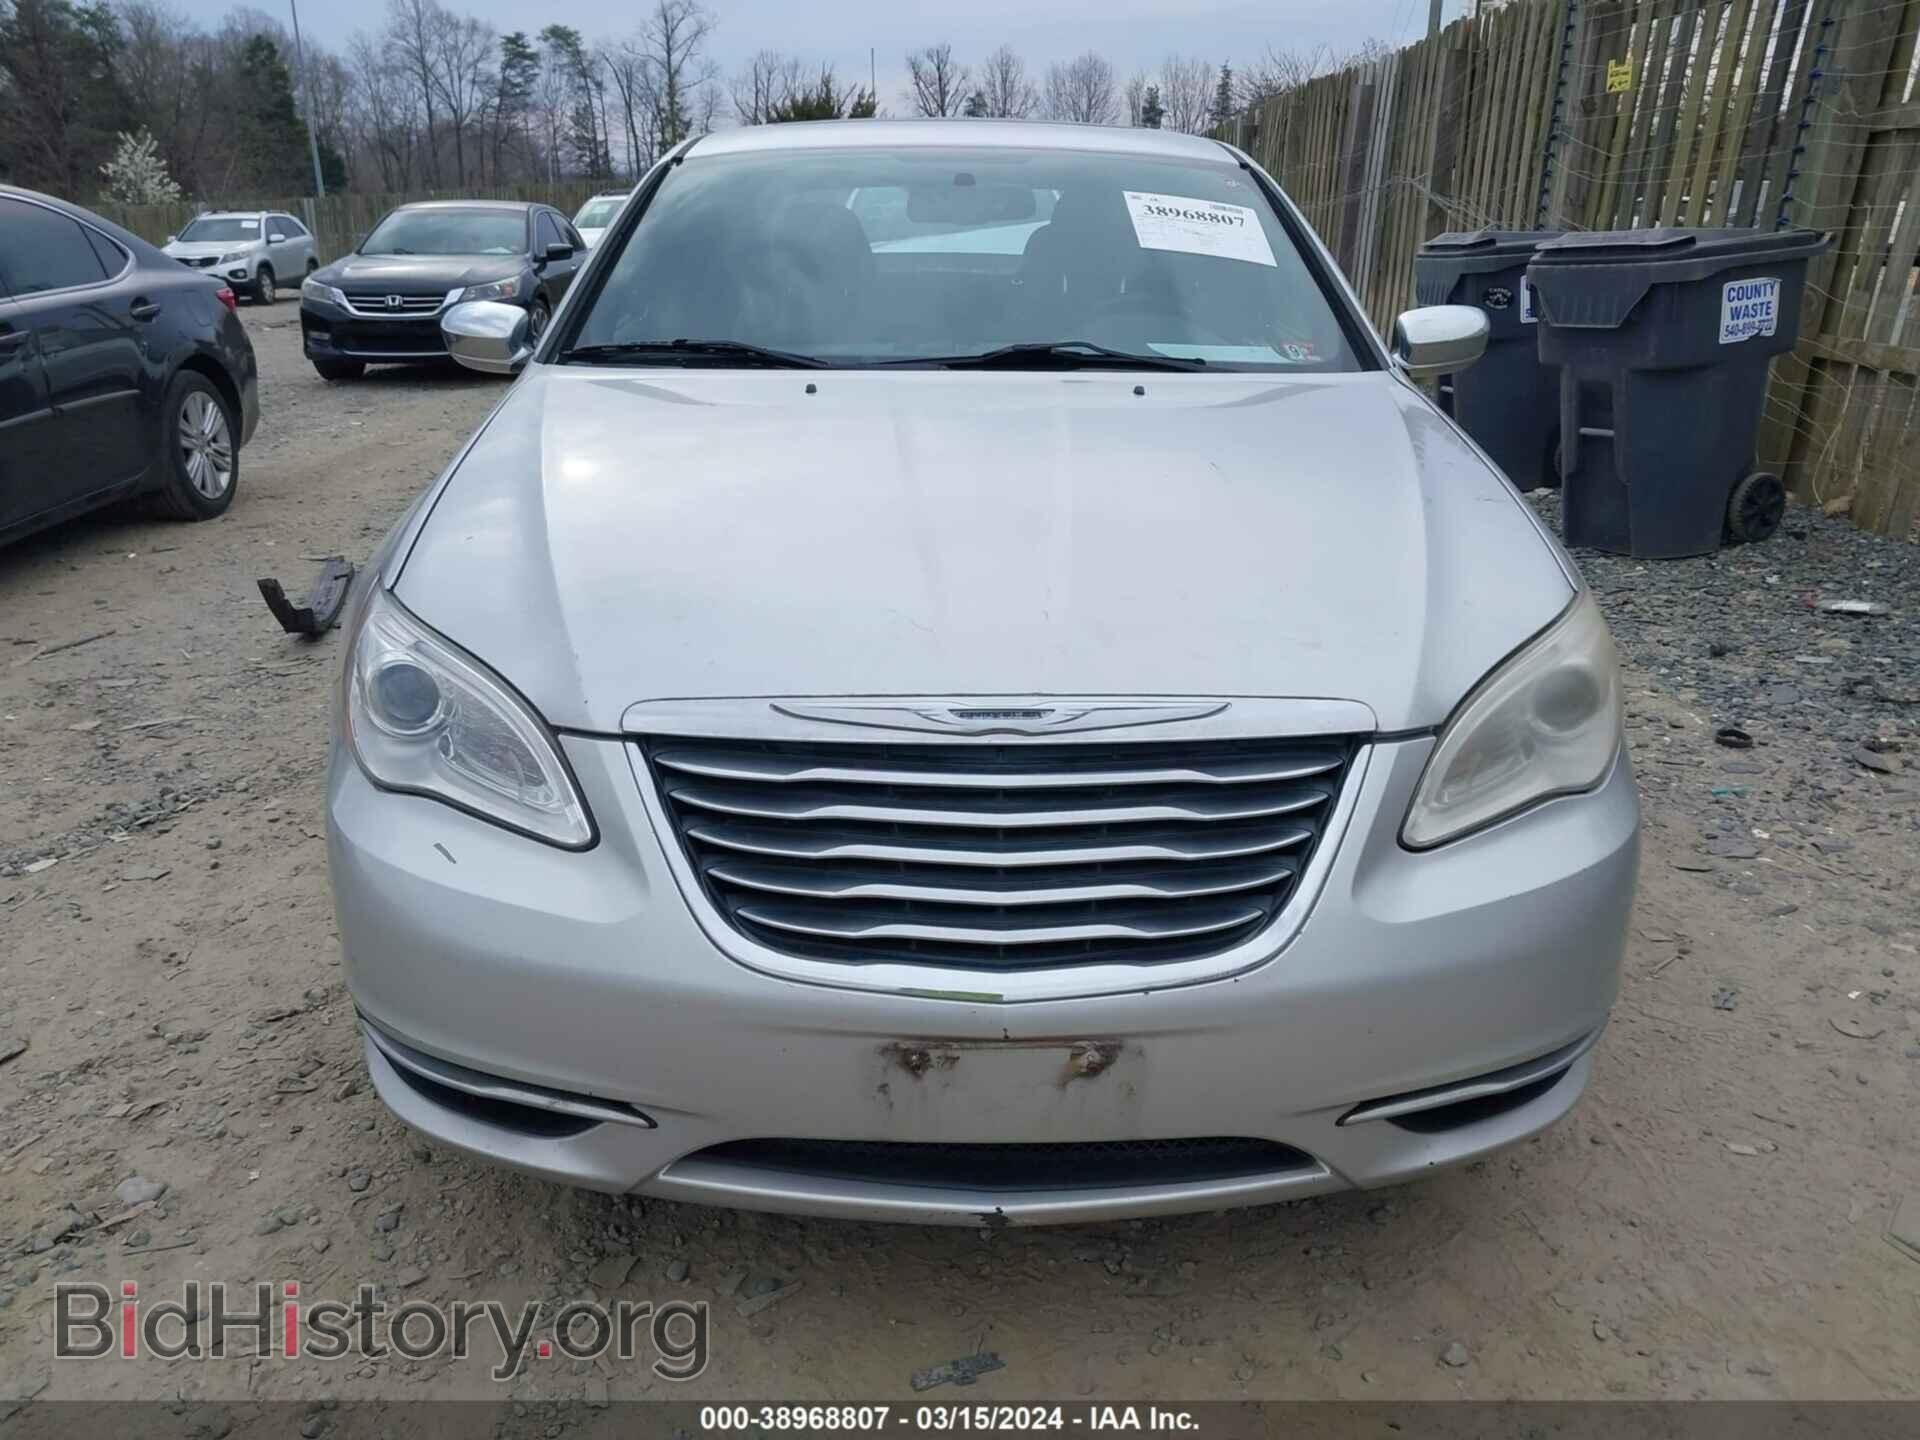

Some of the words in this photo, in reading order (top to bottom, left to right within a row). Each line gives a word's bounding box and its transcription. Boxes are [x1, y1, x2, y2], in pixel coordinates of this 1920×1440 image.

[1143, 204, 1245, 228] 38968807
[1727, 281, 1776, 303] COUNTY
[1730, 301, 1772, 321] WASTE
